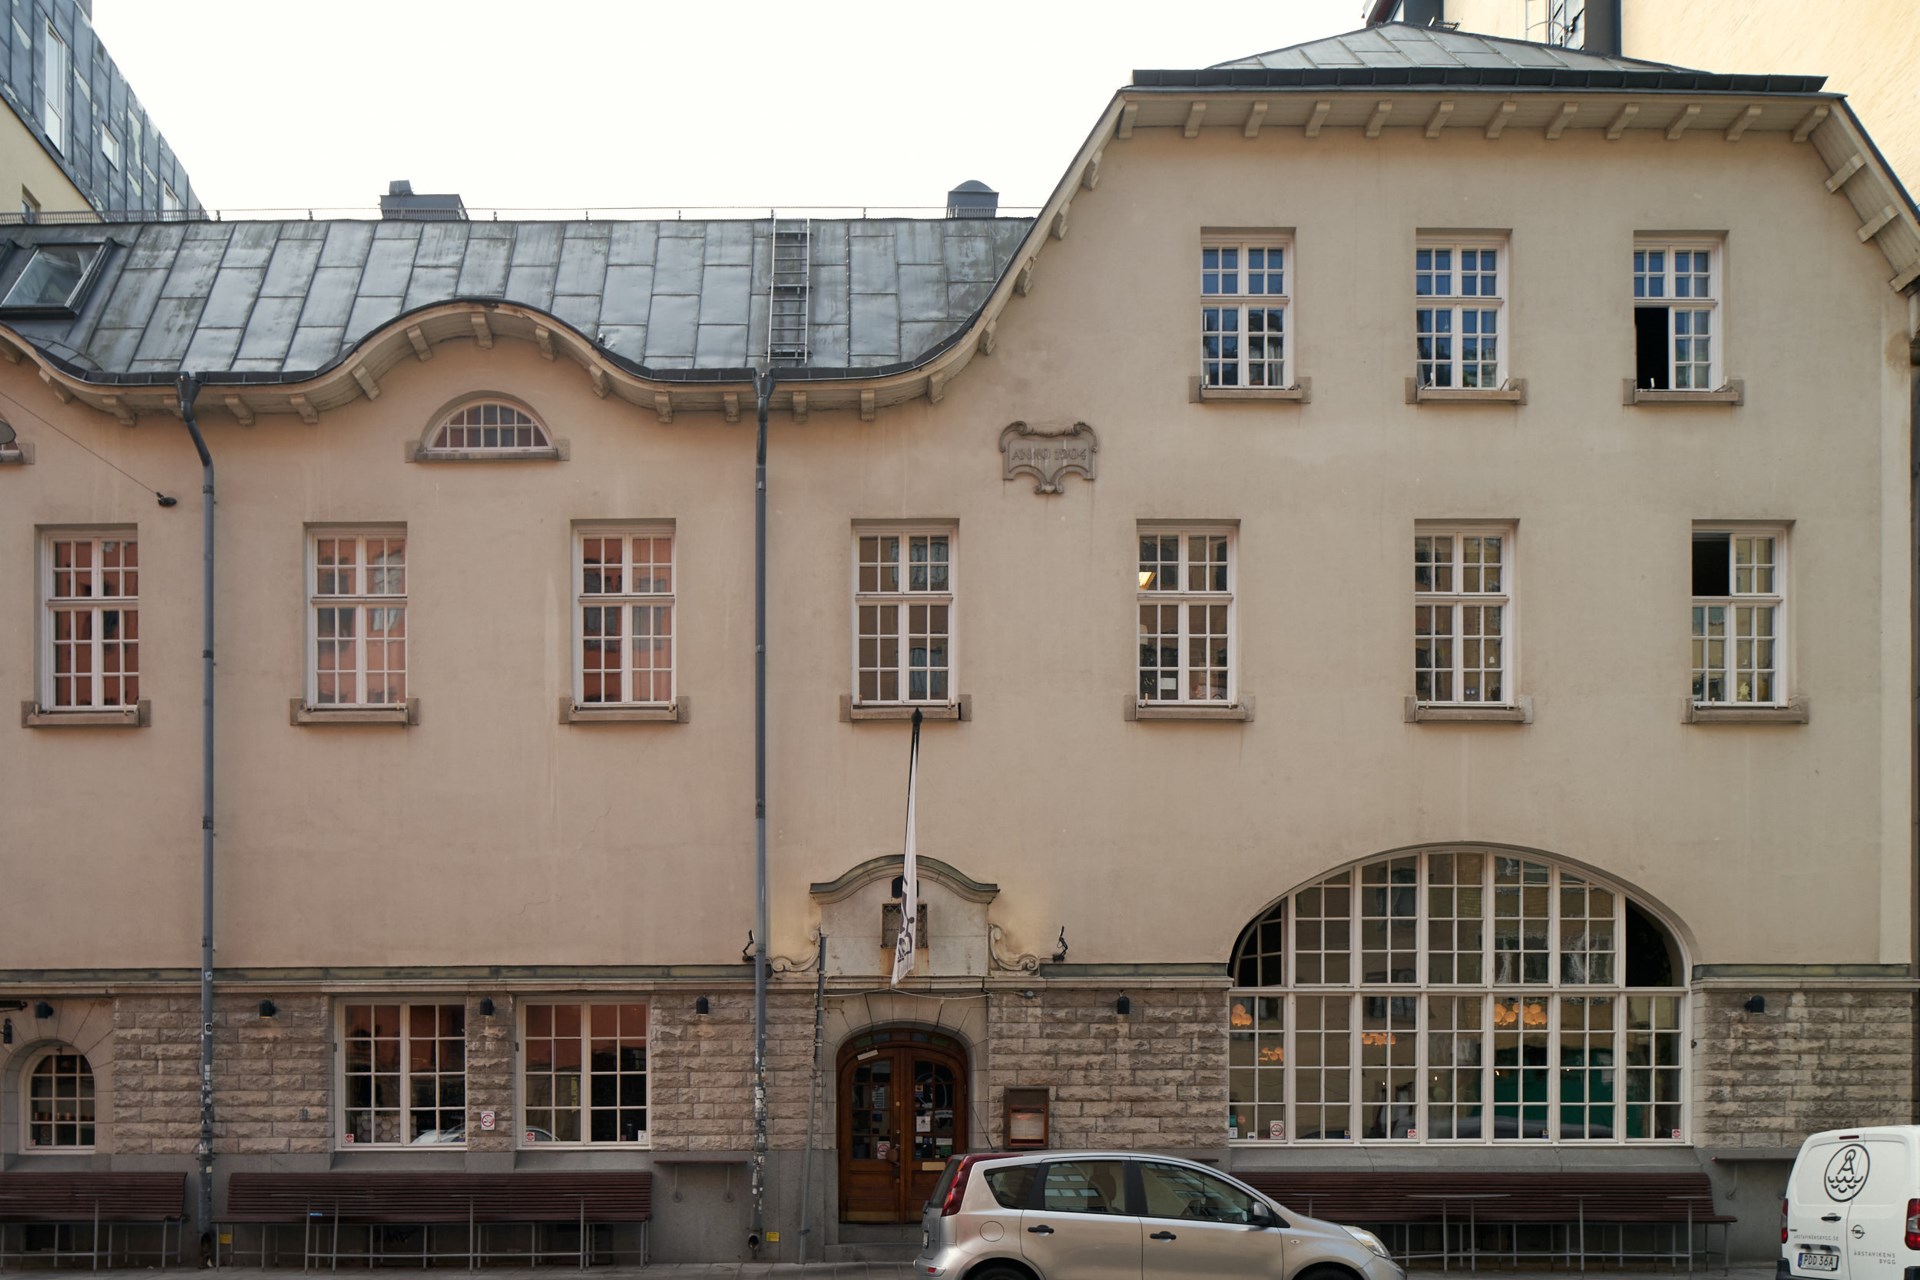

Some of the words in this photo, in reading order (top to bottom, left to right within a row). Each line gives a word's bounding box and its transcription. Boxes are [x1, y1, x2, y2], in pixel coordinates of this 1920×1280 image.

[1011, 448, 1051, 461] ANNO
[1804, 1255, 1818, 1265] PDD
[1819, 1256, 1833, 1266] 36A
